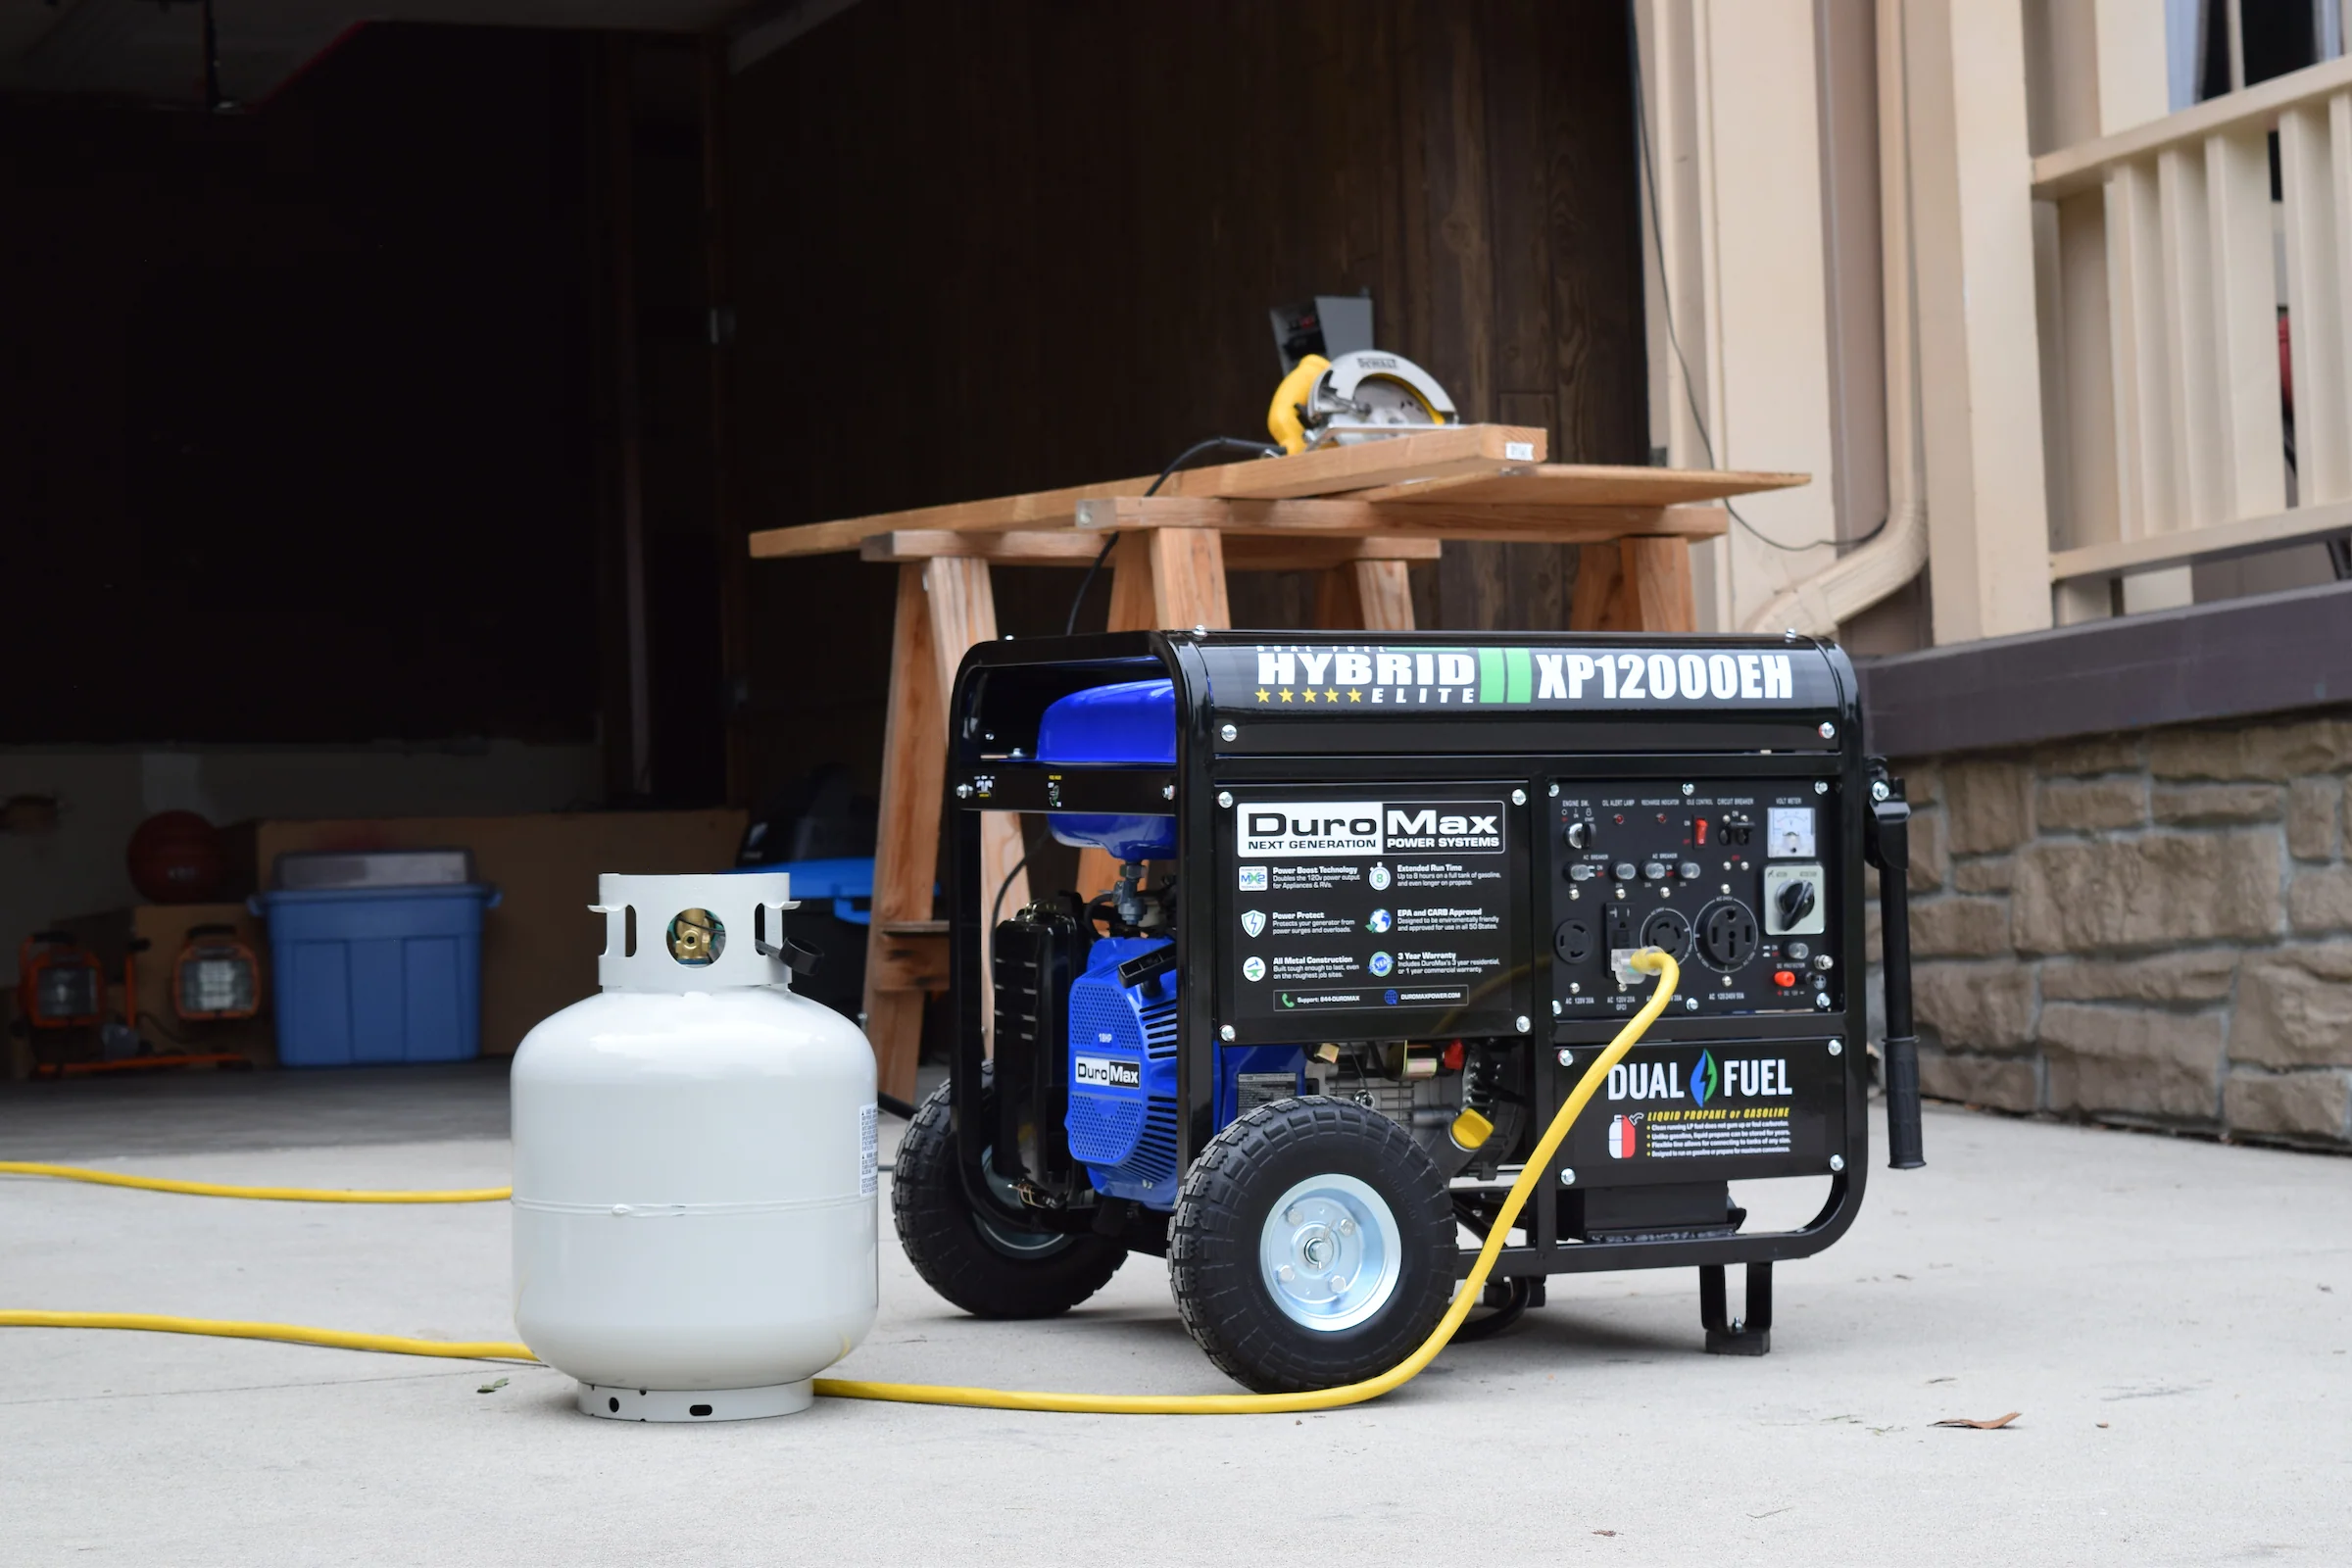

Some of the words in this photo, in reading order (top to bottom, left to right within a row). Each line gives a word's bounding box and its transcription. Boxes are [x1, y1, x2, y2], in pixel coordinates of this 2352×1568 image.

[1257, 652, 1475, 686] HYBRID
[1538, 653, 1793, 700] XP12000EH
[1372, 687, 1475, 704] ELITE
[1290, 839, 1376, 849] GENERATION
[1387, 838, 1435, 848] POWER
[1439, 837, 1499, 847] SYSTEMS
[1377, 874, 1383, 883] 8
[1608, 1062, 1685, 1100] DUAL
[1724, 1059, 1792, 1097] FUEL
[1647, 1111, 1680, 1121] LIQUID
[1684, 1109, 1727, 1120] PROPANE
[1743, 1107, 1789, 1118] GASOLINE
